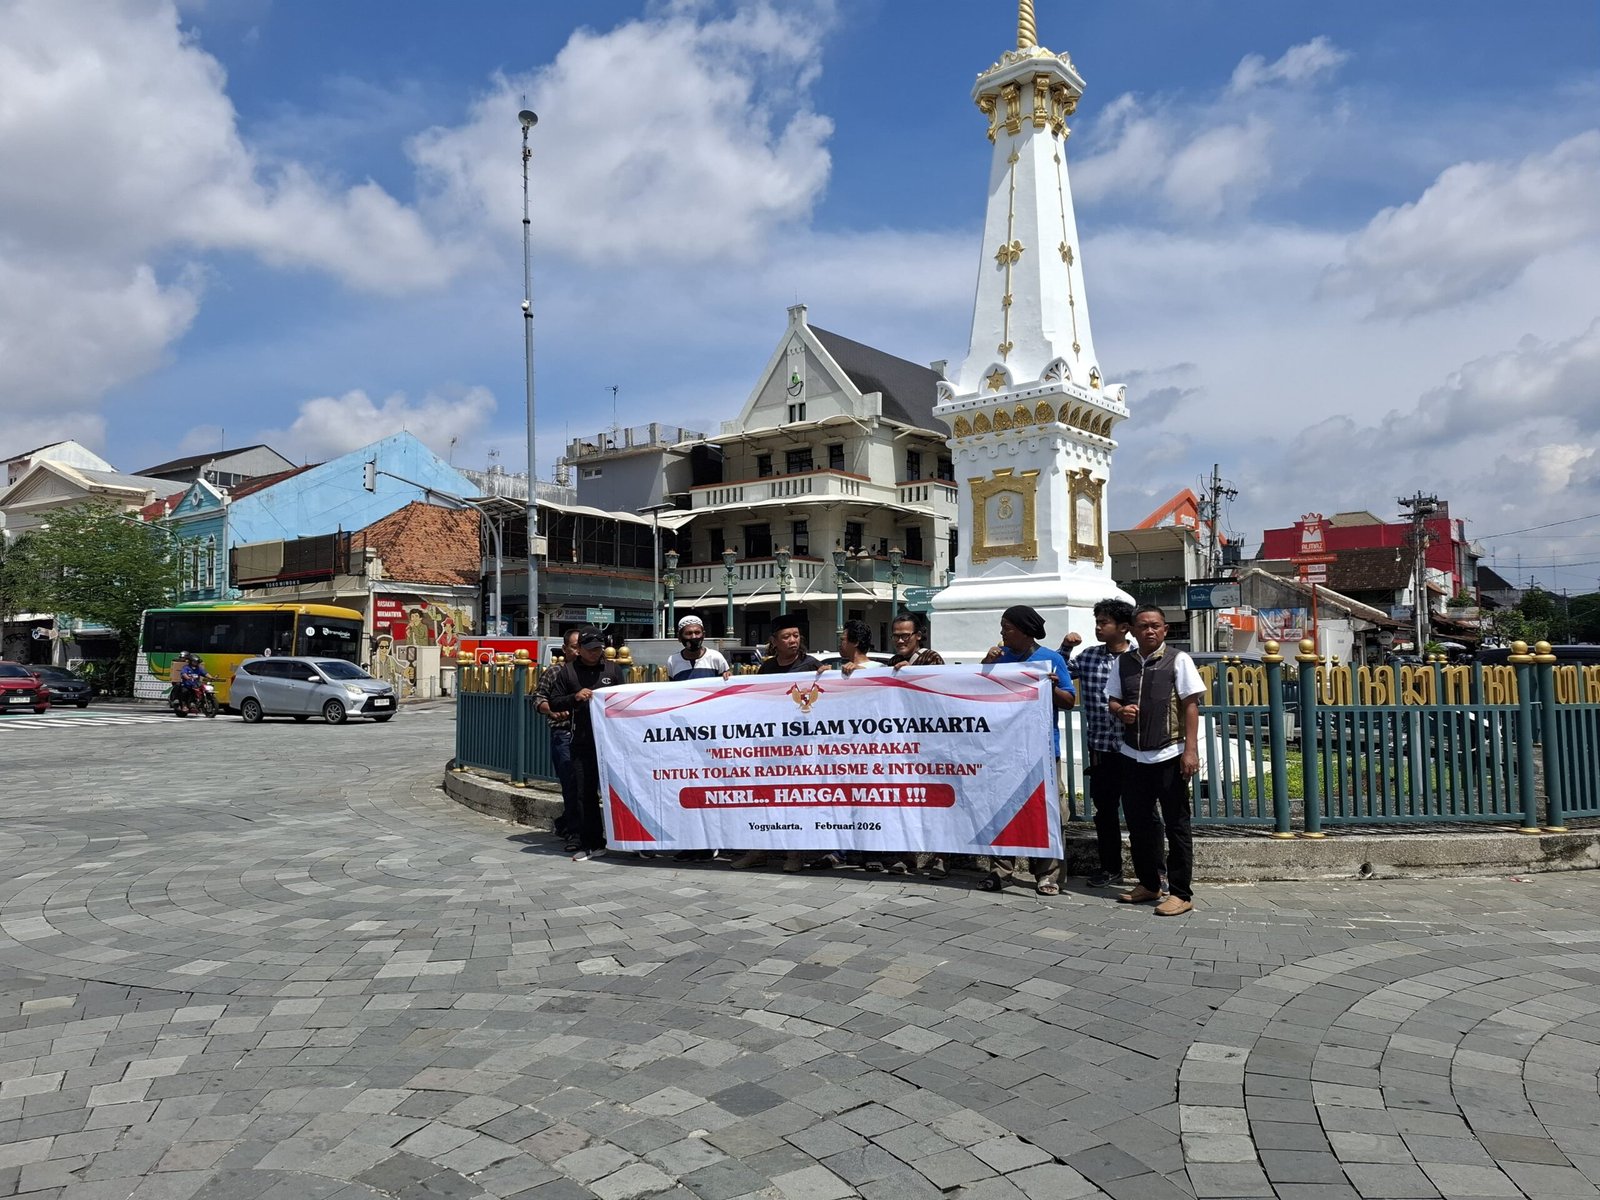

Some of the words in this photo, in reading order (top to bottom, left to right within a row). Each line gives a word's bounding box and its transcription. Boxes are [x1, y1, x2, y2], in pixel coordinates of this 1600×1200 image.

[643, 725, 717, 743] ALIANSI
[722, 722, 776, 739] UMAT
[782, 720, 845, 737] ISLAM
[849, 716, 991, 735] YOGYAKARTA
[705, 744, 813, 759] "MENGHIMBAU
[817, 742, 921, 757] MASYARAKAT
[652, 768, 699, 780] UNTUK
[702, 766, 751, 779] TOLAK
[755, 763, 868, 777] RADIAKALISME
[872, 762, 885, 775] &
[888, 762, 983, 776] INTOLERAN"
[704, 789, 769, 804] NKRI...
[774, 788, 848, 803] HARGA
[851, 787, 900, 803] MATI
[906, 787, 927, 803] !!!
[748, 821, 803, 832] Yogyakarta,
[815, 821, 855, 831] Februari
[857, 821, 882, 831] 2026
